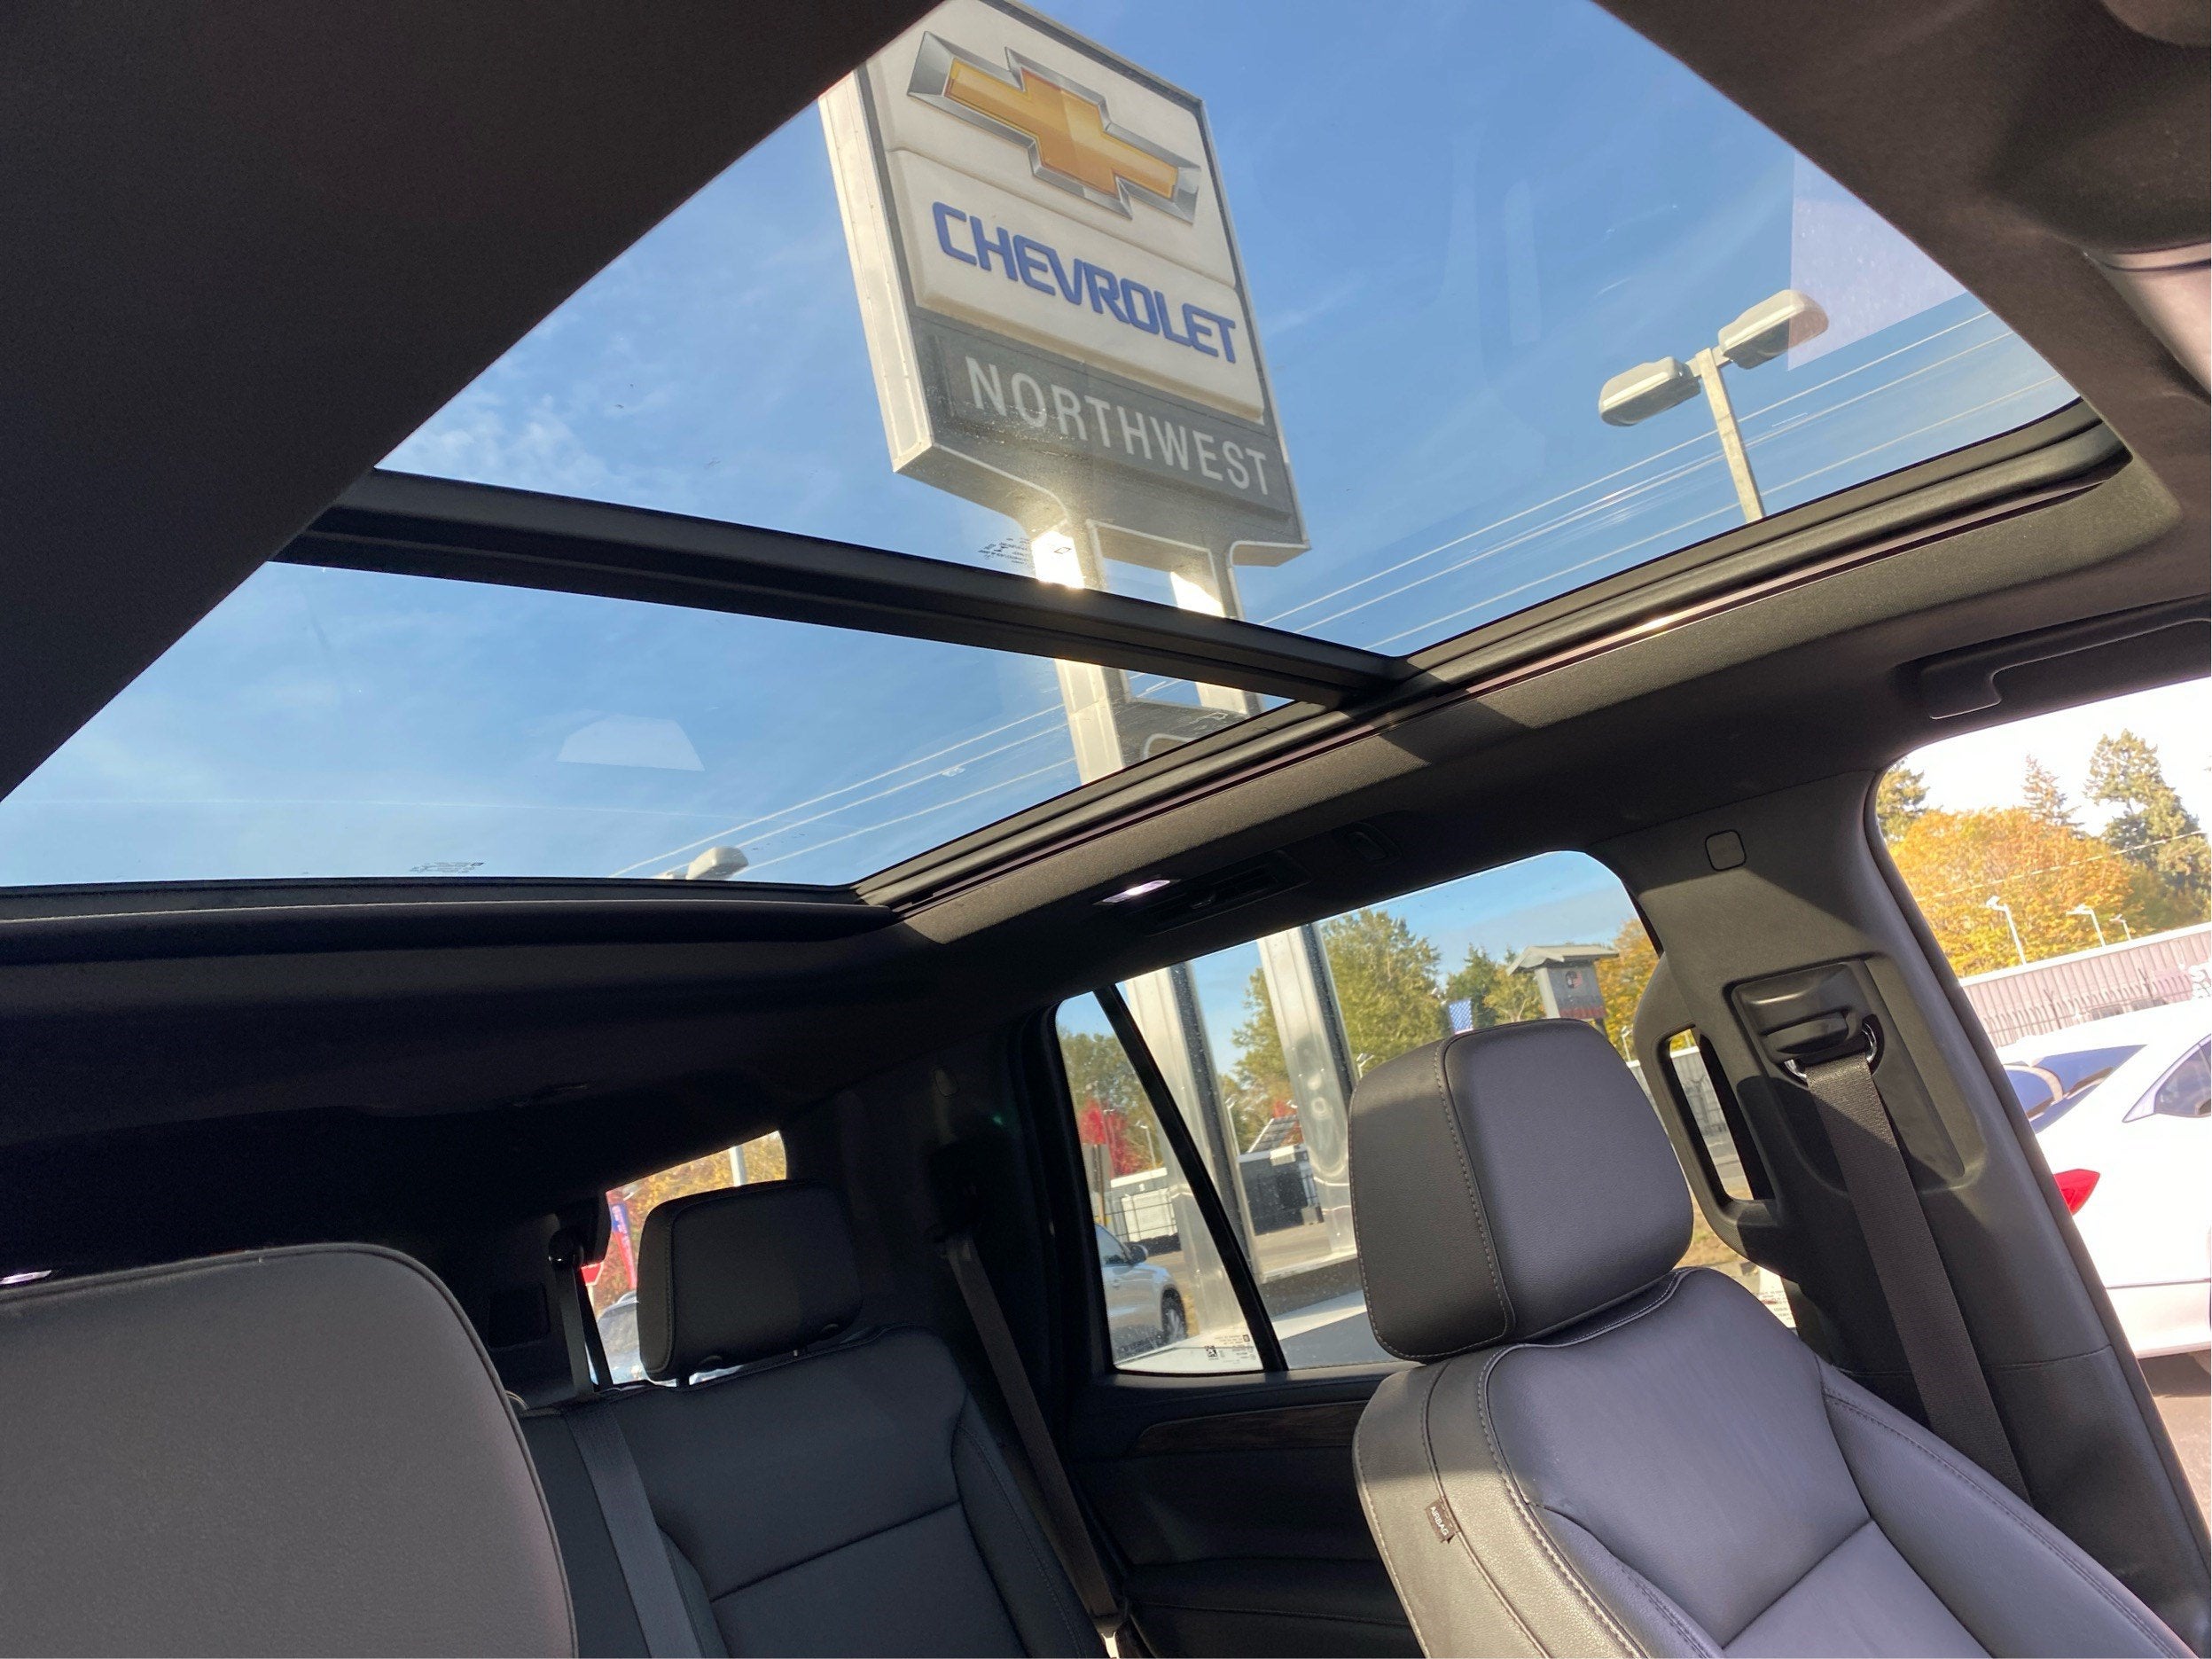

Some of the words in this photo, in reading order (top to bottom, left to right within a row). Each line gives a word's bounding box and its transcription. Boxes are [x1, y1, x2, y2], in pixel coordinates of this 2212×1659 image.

[933, 202, 1236, 363] CHEVROLET
[965, 356, 1269, 495] NORTHWEST
[1430, 1506, 1449, 1536] AIRBAG
